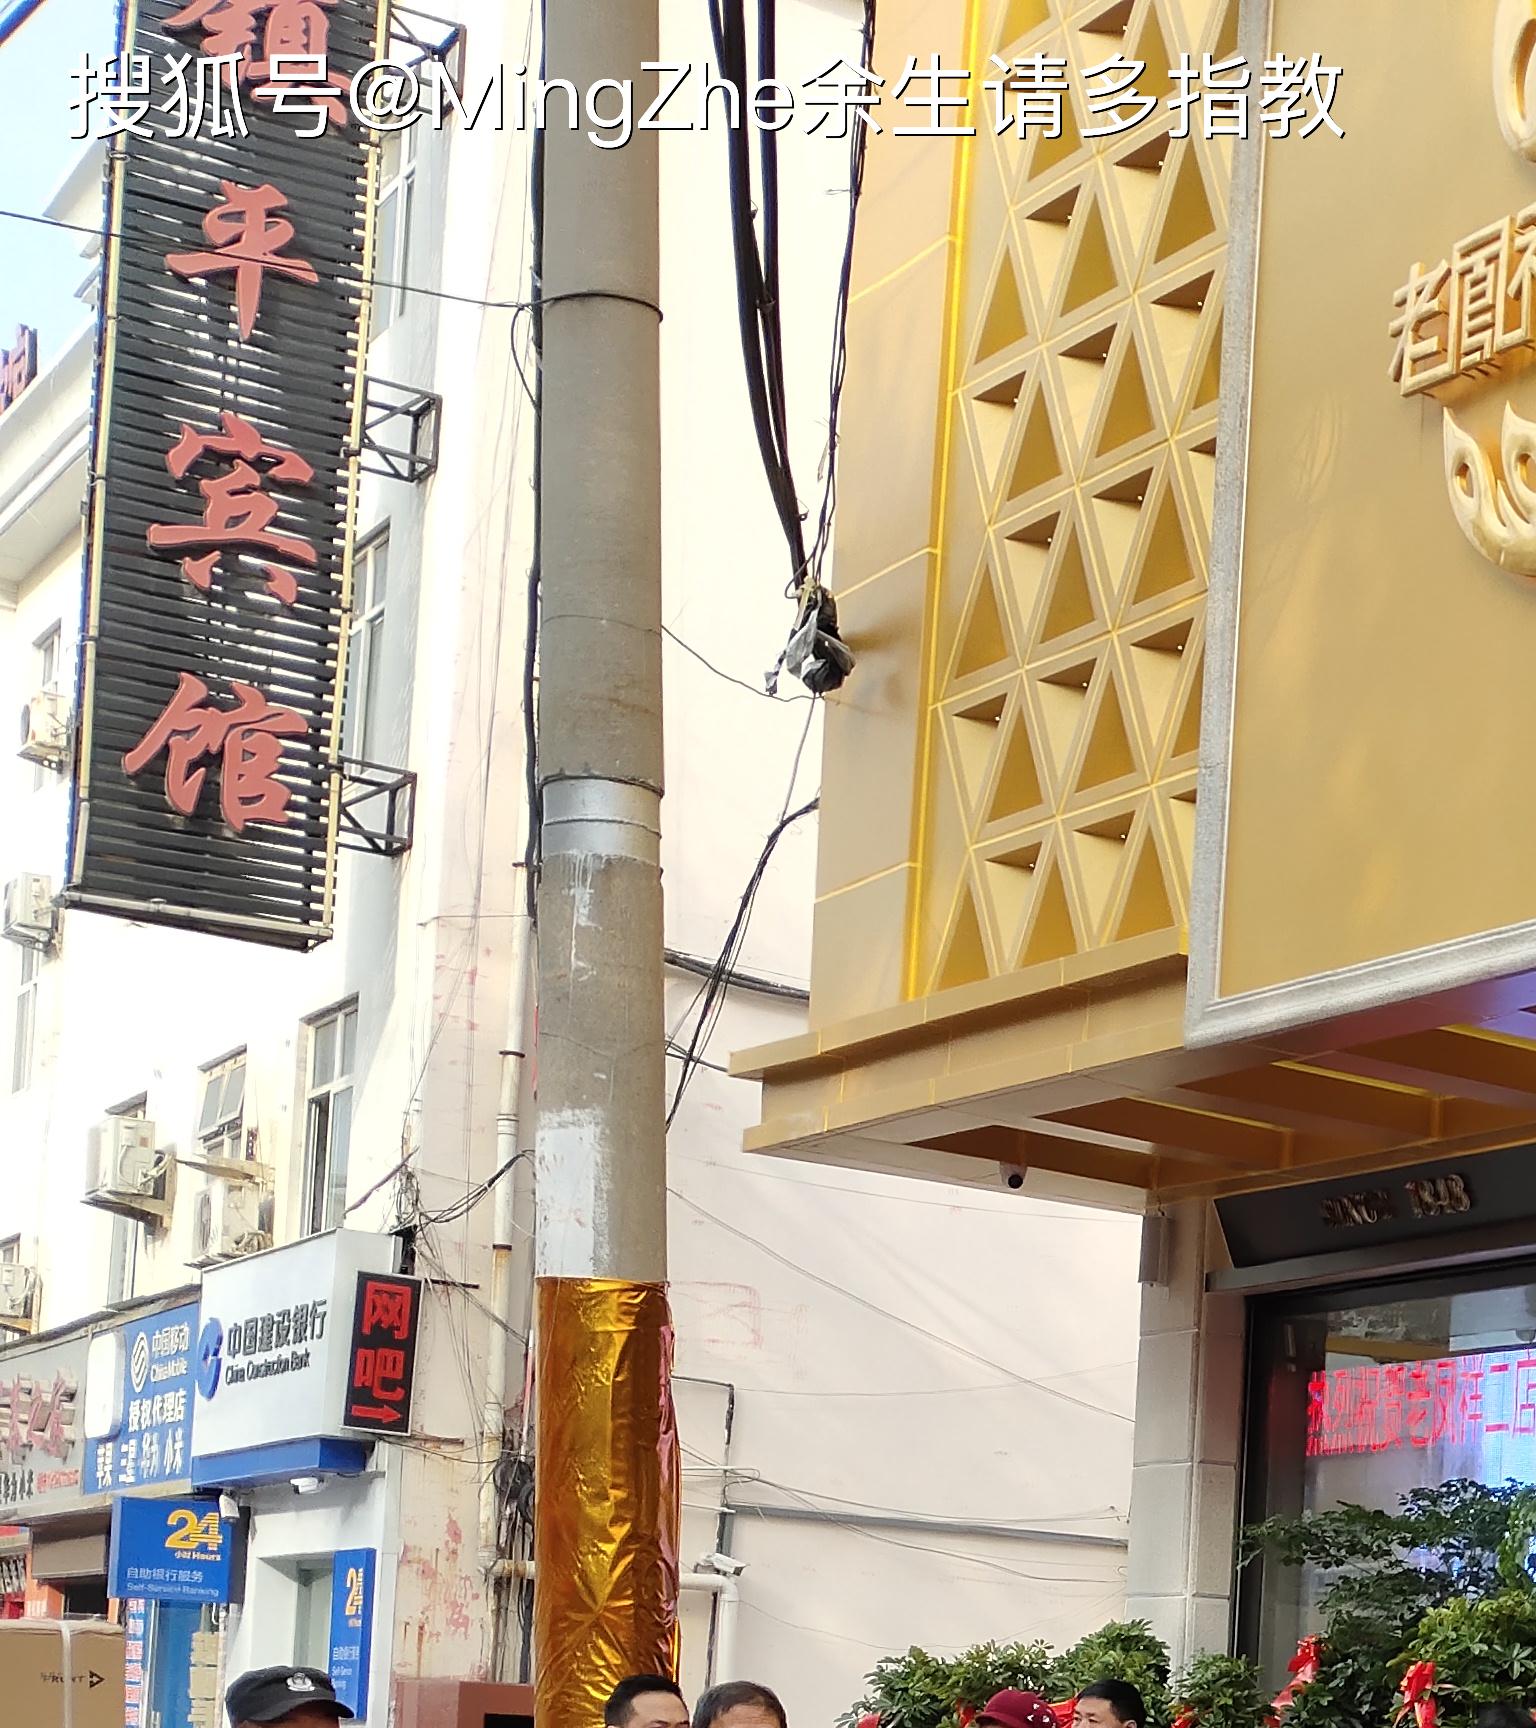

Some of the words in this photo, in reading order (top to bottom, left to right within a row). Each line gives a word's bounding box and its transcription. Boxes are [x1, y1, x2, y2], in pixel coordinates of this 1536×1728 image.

[152, 1321, 189, 1359] 中国移动
[226, 1299, 328, 1359] 中国建设银行
[354, 1280, 412, 1400] 网吧
[165, 1508, 222, 1551] 24
[126, 1567, 203, 1583] 自助银行服务
